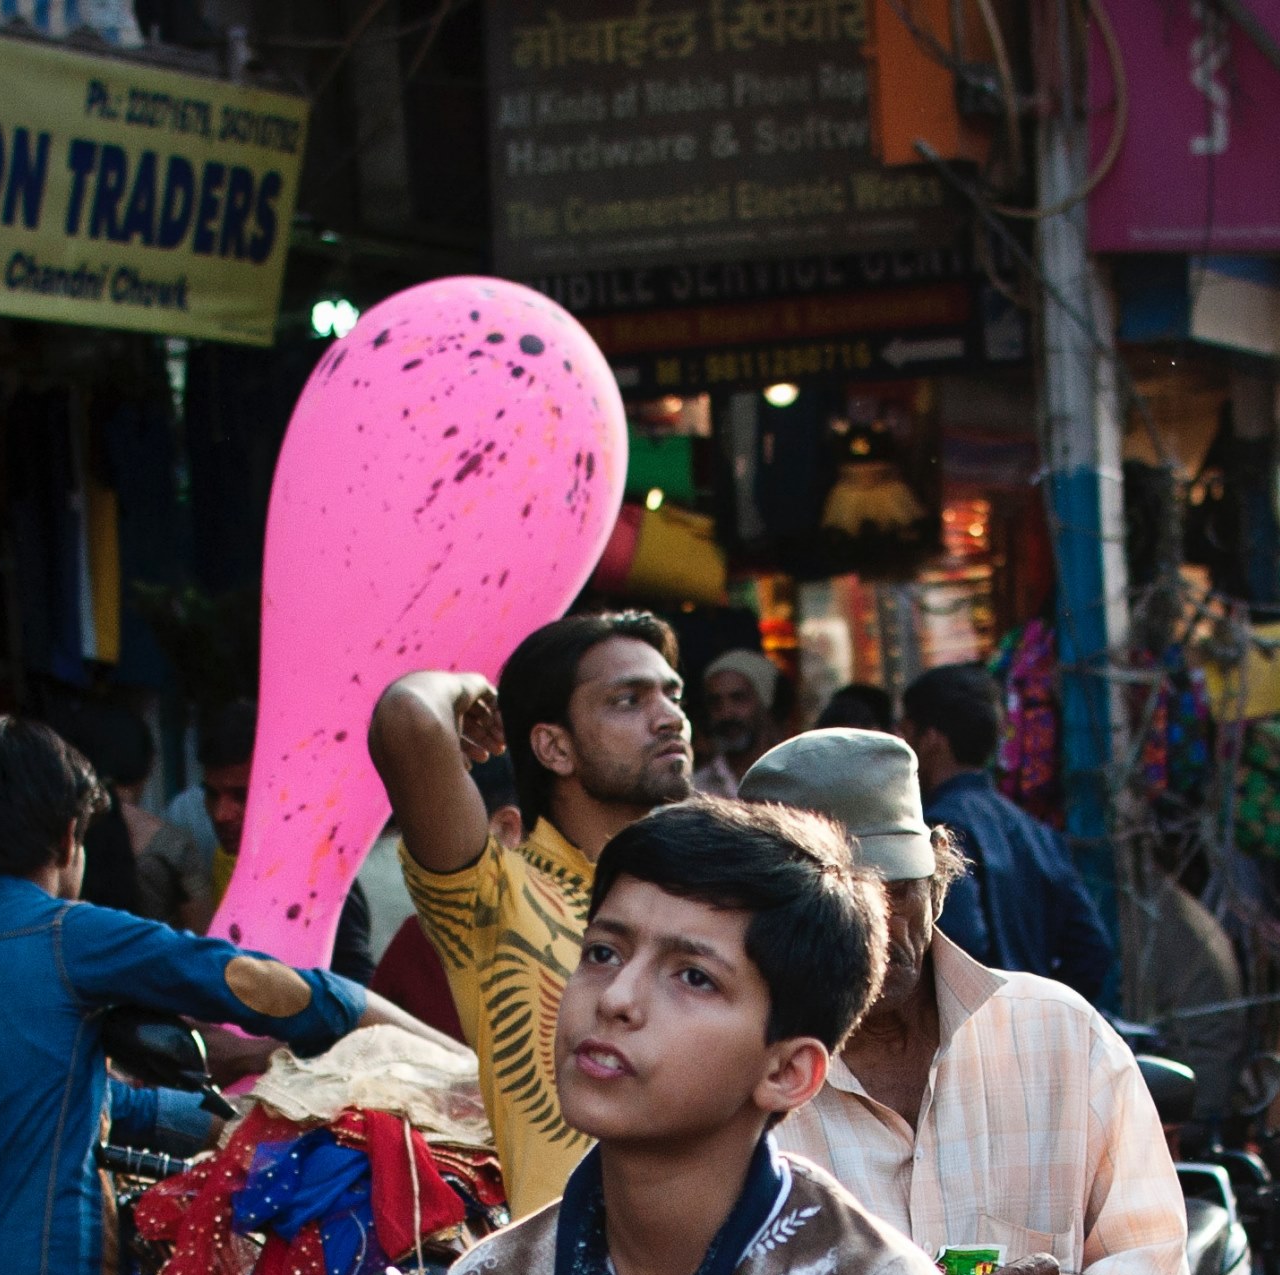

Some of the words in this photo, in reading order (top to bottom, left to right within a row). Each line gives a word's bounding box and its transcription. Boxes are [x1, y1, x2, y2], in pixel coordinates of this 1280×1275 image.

[504, 132, 698, 177] Hardware
[711, 120, 741, 159] &
[65, 138, 282, 265] TRADERS
[3, 250, 110, 303] Chandni
[109, 266, 190, 311] Chowk
